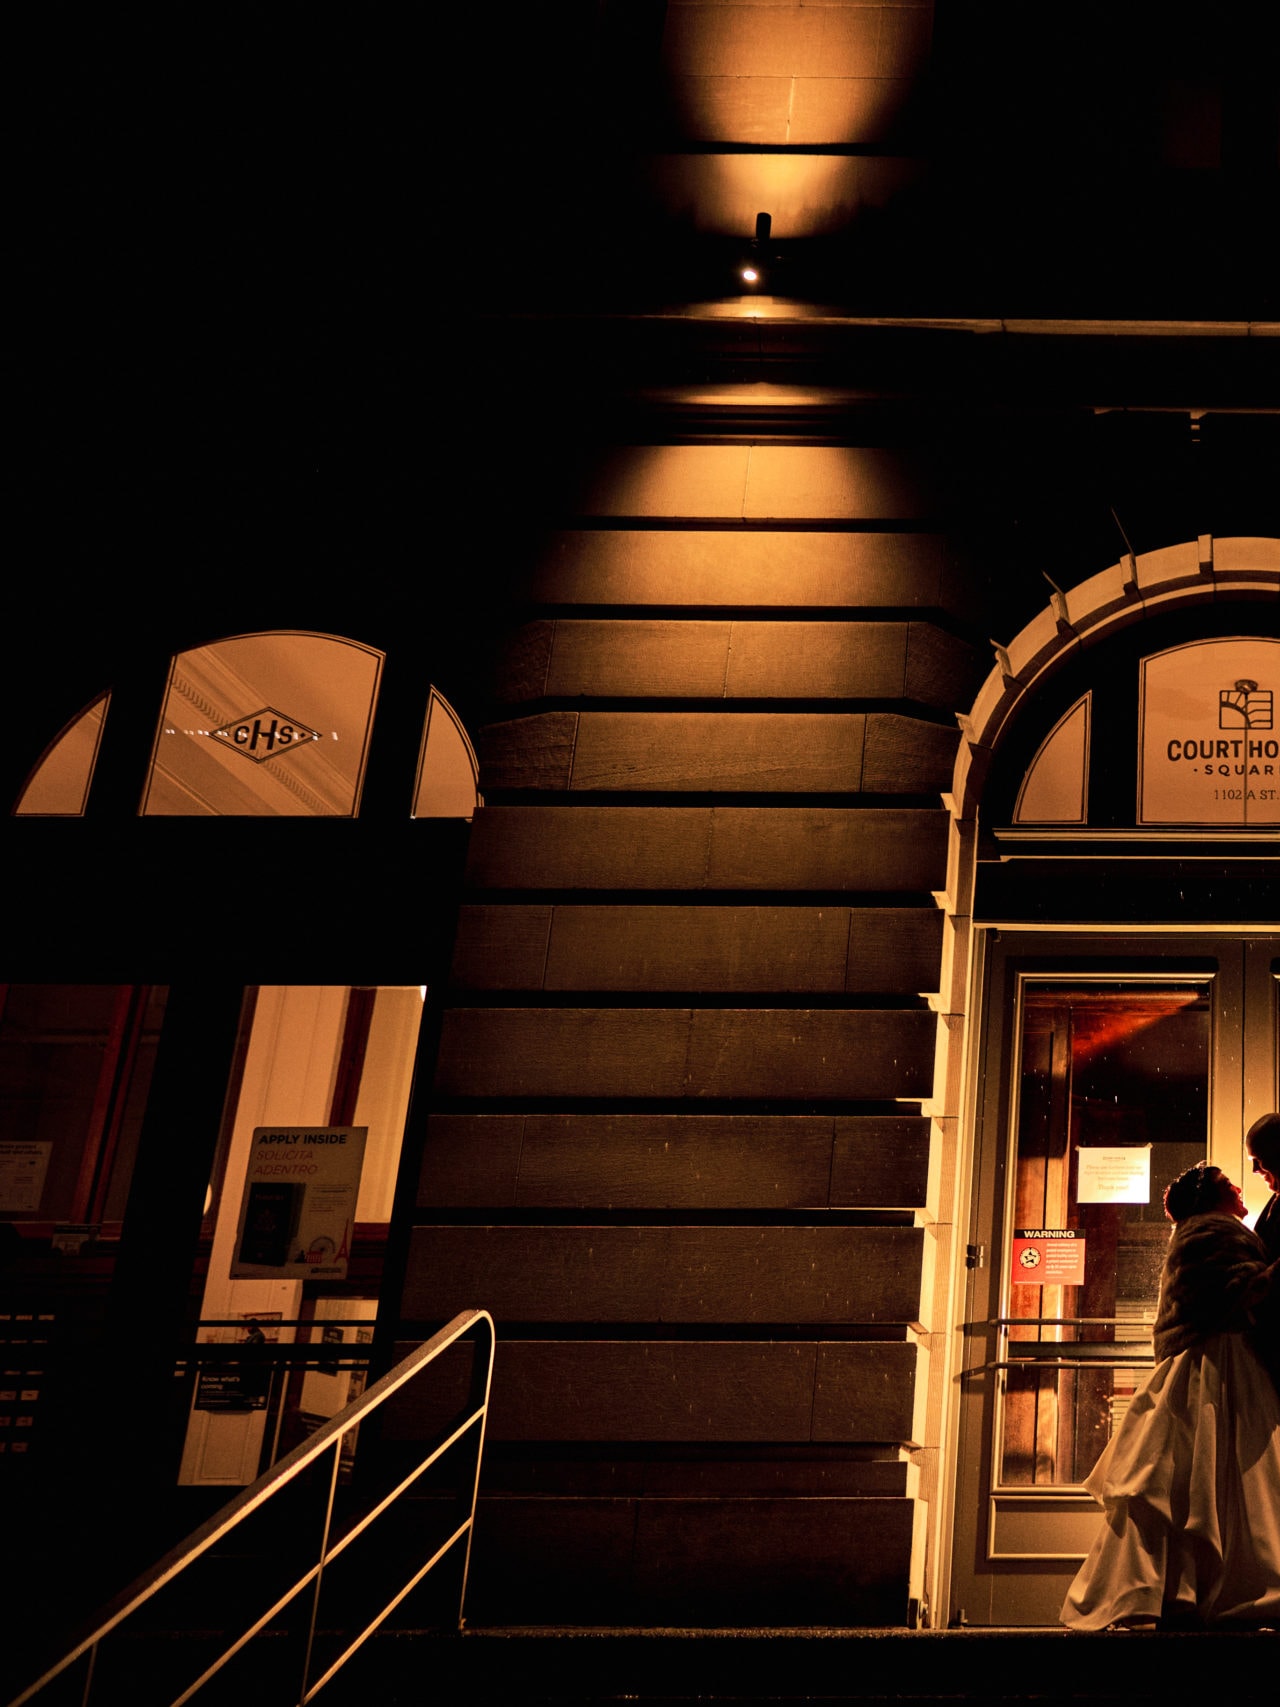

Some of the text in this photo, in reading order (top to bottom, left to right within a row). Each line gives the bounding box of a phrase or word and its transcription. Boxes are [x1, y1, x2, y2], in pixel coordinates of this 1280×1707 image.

[234, 720, 294, 750] CHS
[1214, 789, 1280, 800] 1102 A ST.
[258, 1134, 348, 1145] APPLY INSIDE
[255, 1150, 313, 1161] SOLICITA
[253, 1164, 318, 1175] ADENTRO
[1023, 1230, 1076, 1239] WARNING
